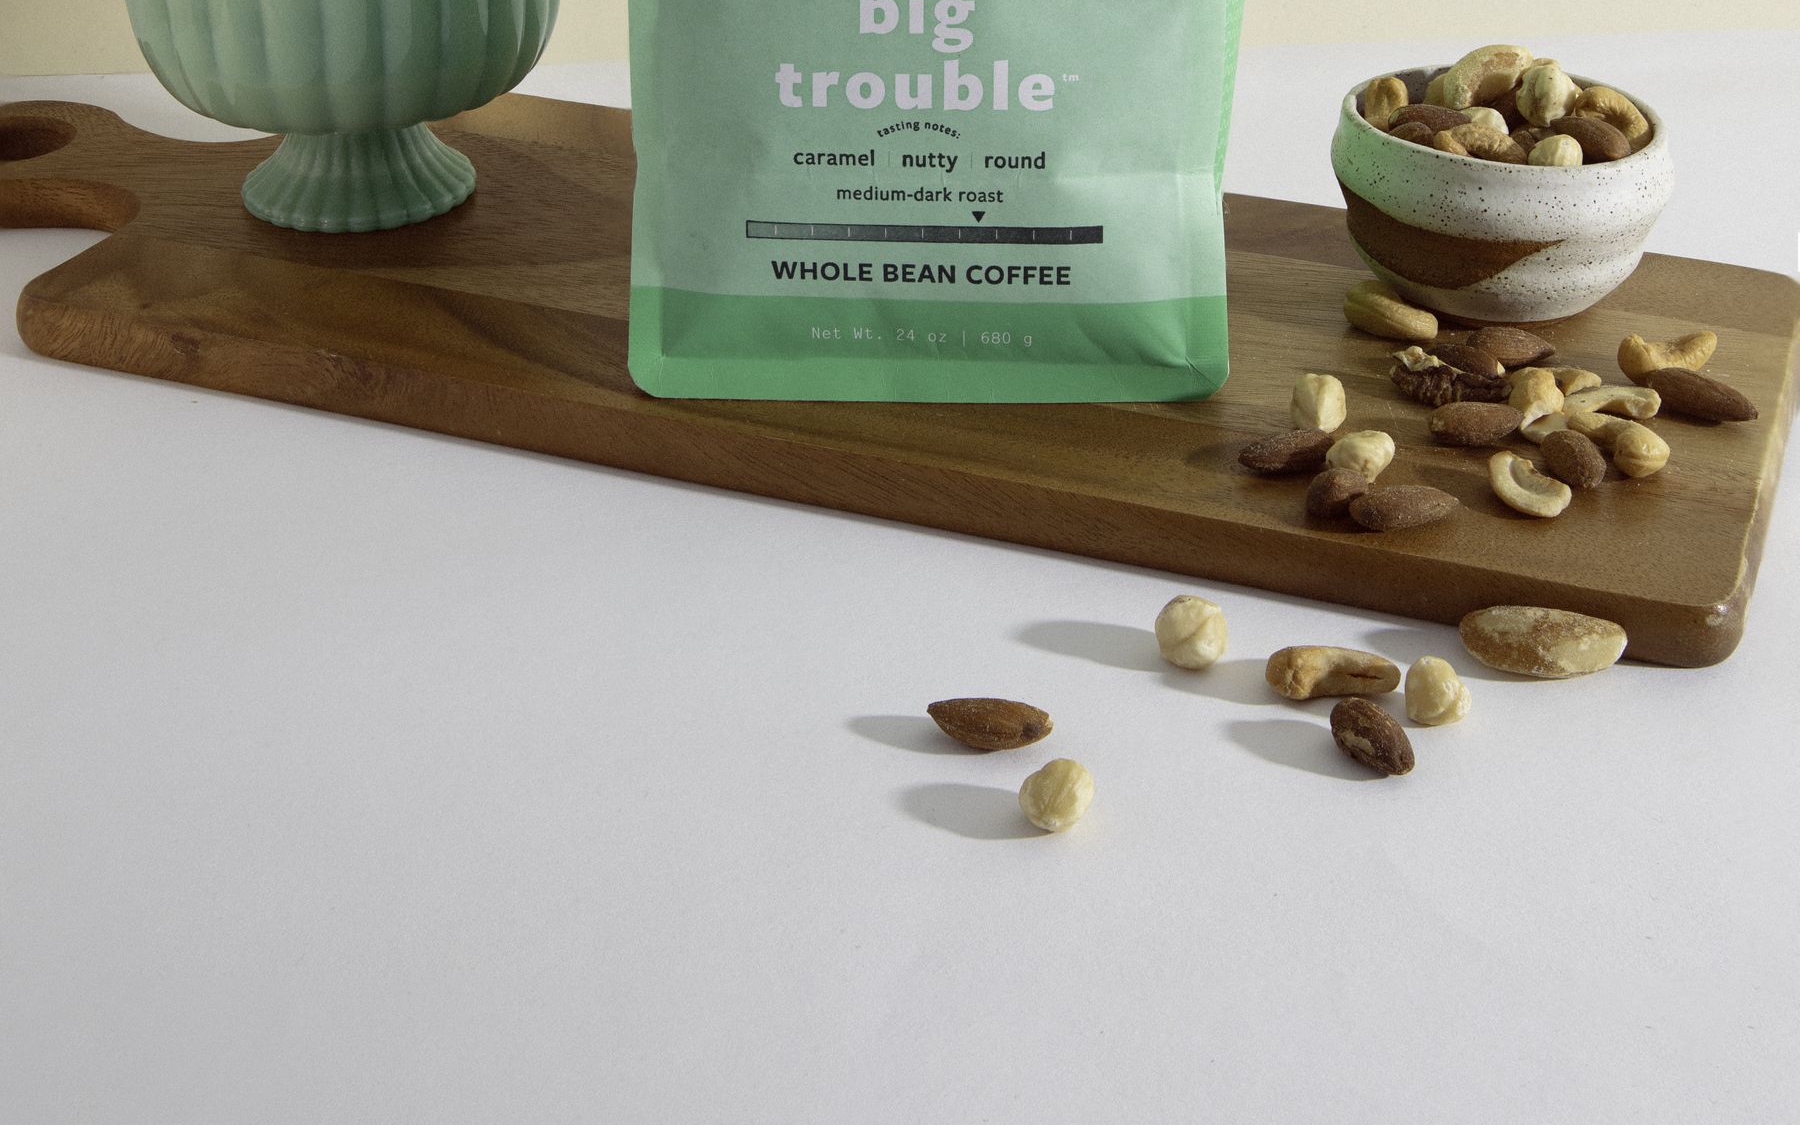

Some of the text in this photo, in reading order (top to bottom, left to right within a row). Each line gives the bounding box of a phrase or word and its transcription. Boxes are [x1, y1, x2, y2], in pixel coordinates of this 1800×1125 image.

[774, 59, 1056, 111] trouble
[876, 120, 961, 140] tasting notes:
[793, 149, 1046, 173] caramel nutty round
[836, 186, 1004, 203] medium-dark roast
[771, 260, 1071, 286] WHOLE BEAN COFFEE
[811, 327, 841, 340] Net
[853, 328, 883, 340] Wt.
[896, 329, 915, 342] 24
[928, 332, 947, 343] oz
[980, 332, 1011, 345] 680
[1024, 334, 1033, 347] g
